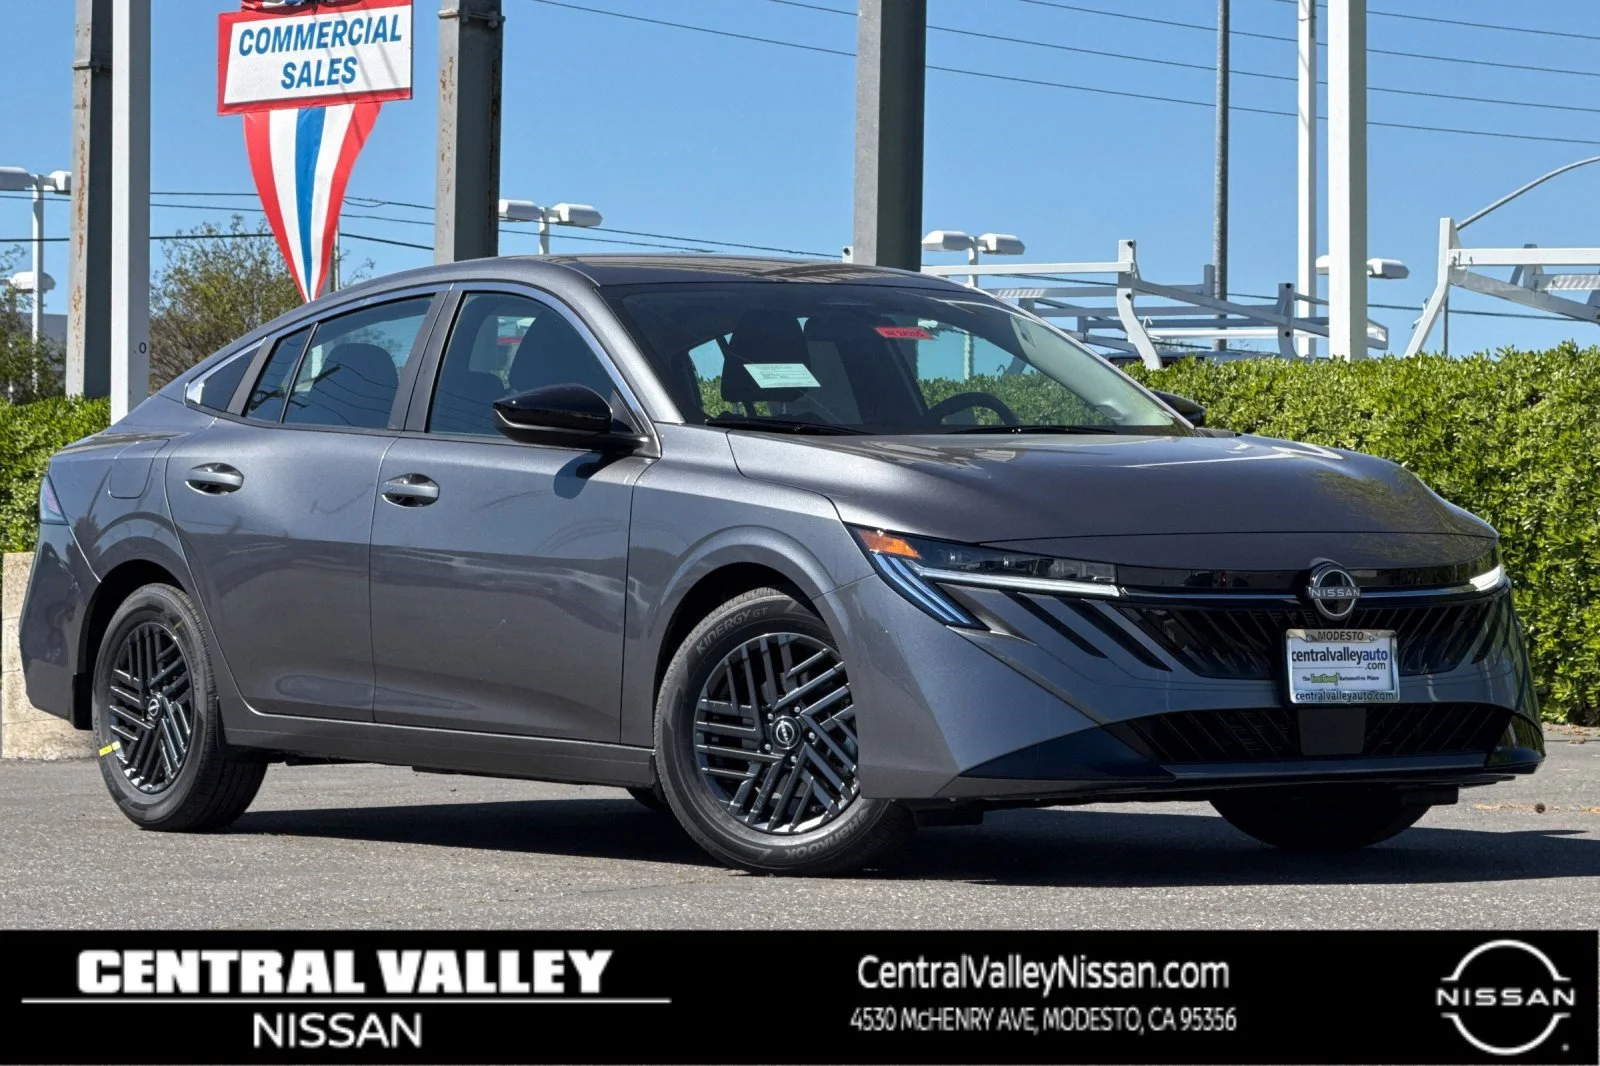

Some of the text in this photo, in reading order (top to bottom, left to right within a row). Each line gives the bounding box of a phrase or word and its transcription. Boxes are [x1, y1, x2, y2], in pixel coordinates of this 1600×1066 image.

[239, 14, 402, 56] COMMERCIAL
[281, 56, 358, 90] SALES
[1311, 588, 1360, 597] NISSAN
[696, 607, 769, 654] KINERGY GT
[1317, 631, 1364, 641] MODESTO
[1292, 646, 1388, 665] centralvalleyauto
[1364, 662, 1386, 670] .com
[1295, 690, 1394, 702] centralvalleyauto.com
